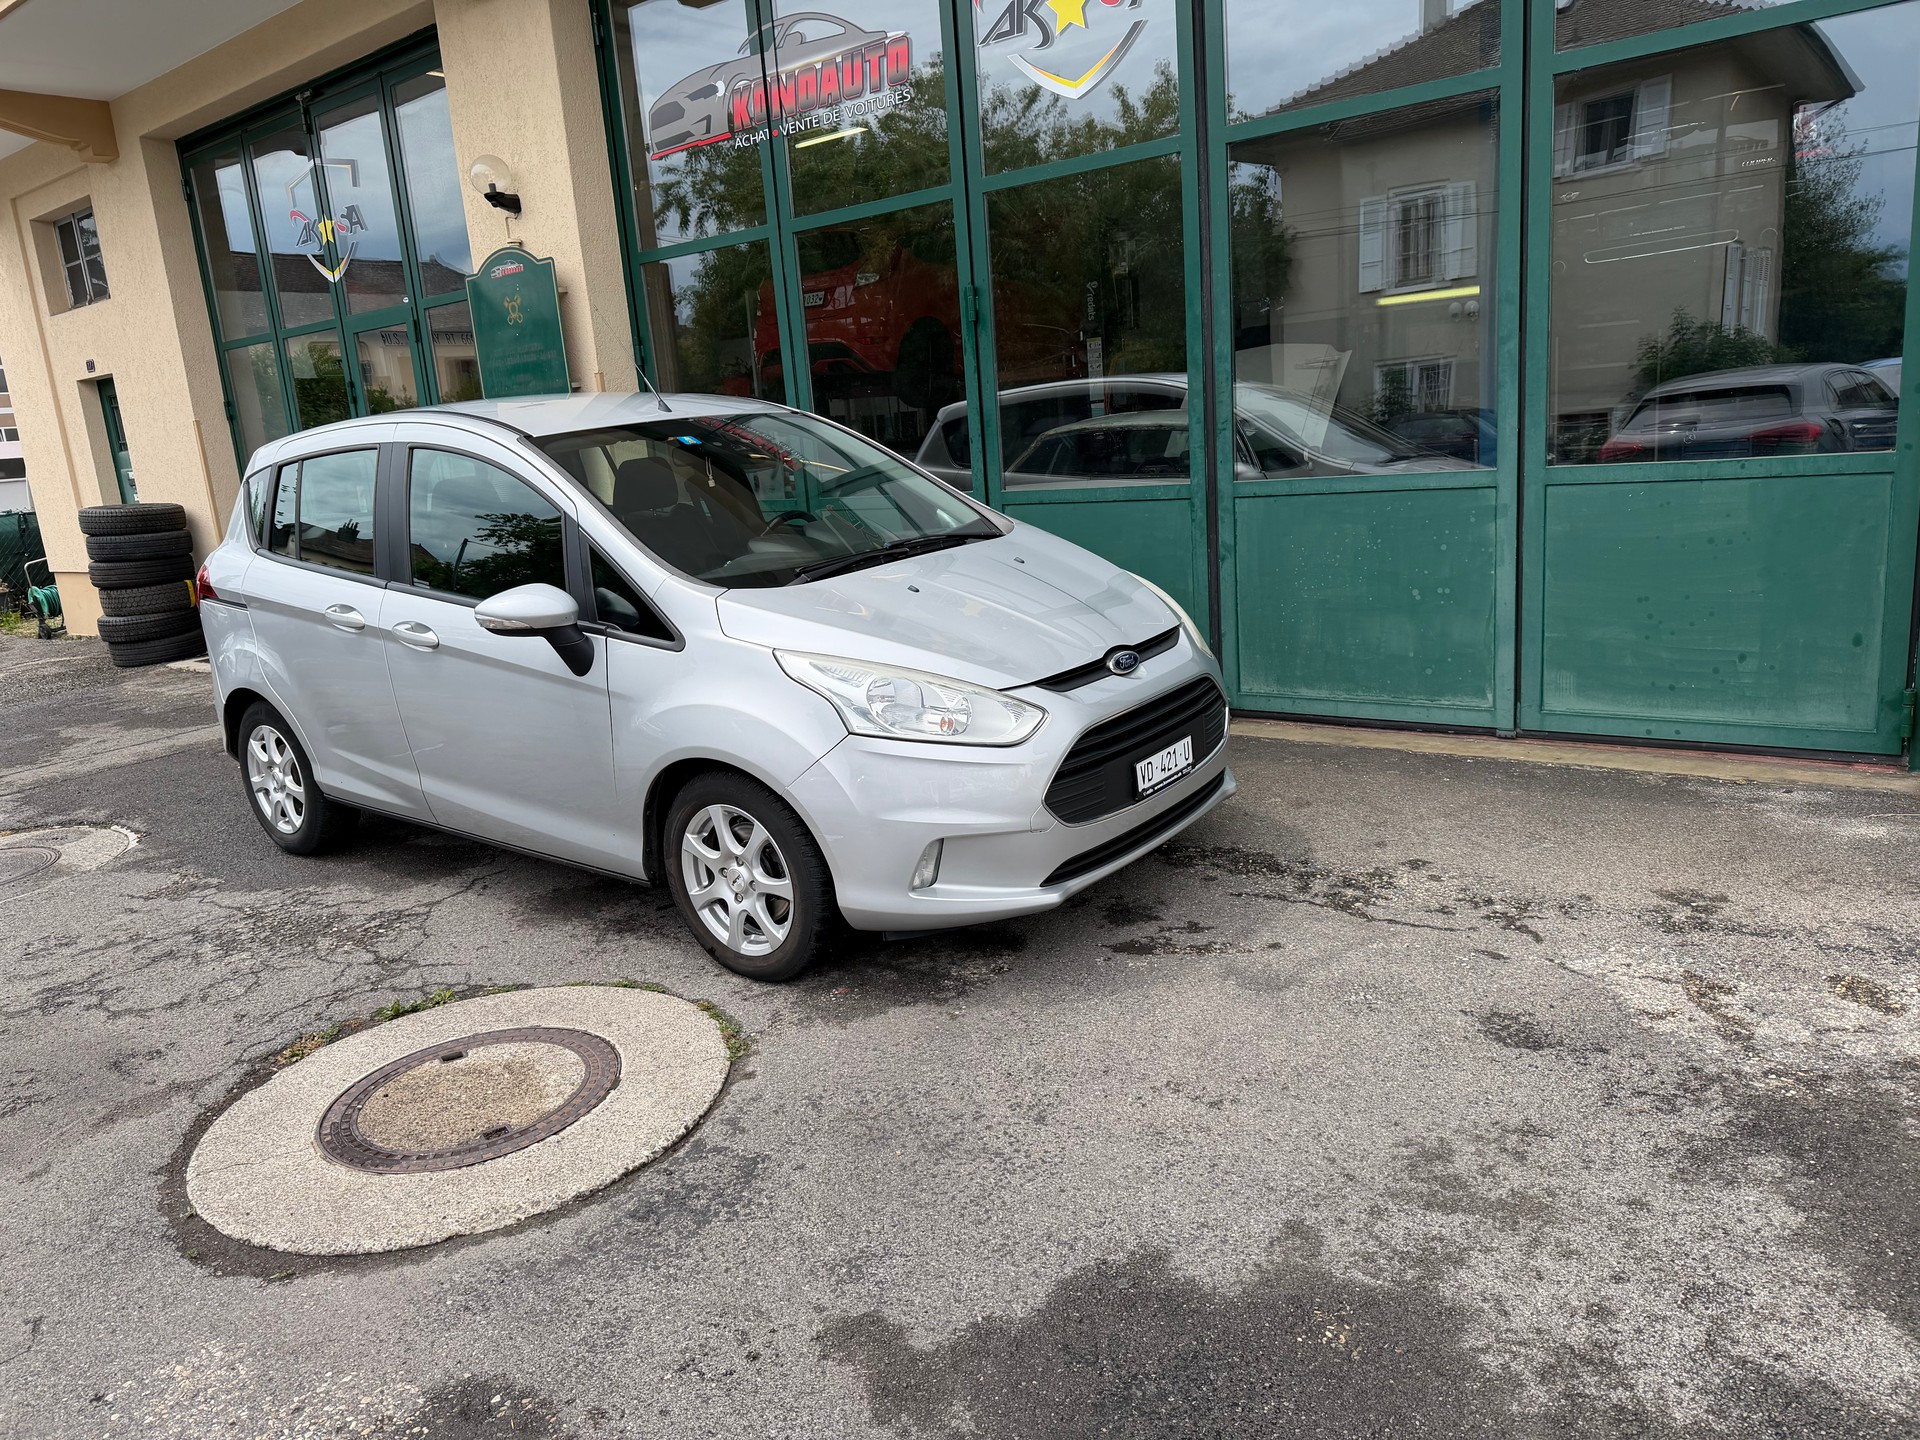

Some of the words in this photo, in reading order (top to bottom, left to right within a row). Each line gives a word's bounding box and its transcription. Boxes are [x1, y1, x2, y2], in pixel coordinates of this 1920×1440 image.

[733, 36, 910, 132] KONOAUTO
[734, 130, 770, 149] ACHAT
[779, 116, 819, 136] VENTE
[823, 109, 841, 125] DE
[845, 88, 911, 118] VOITURES
[1120, 654, 1135, 669] Ford
